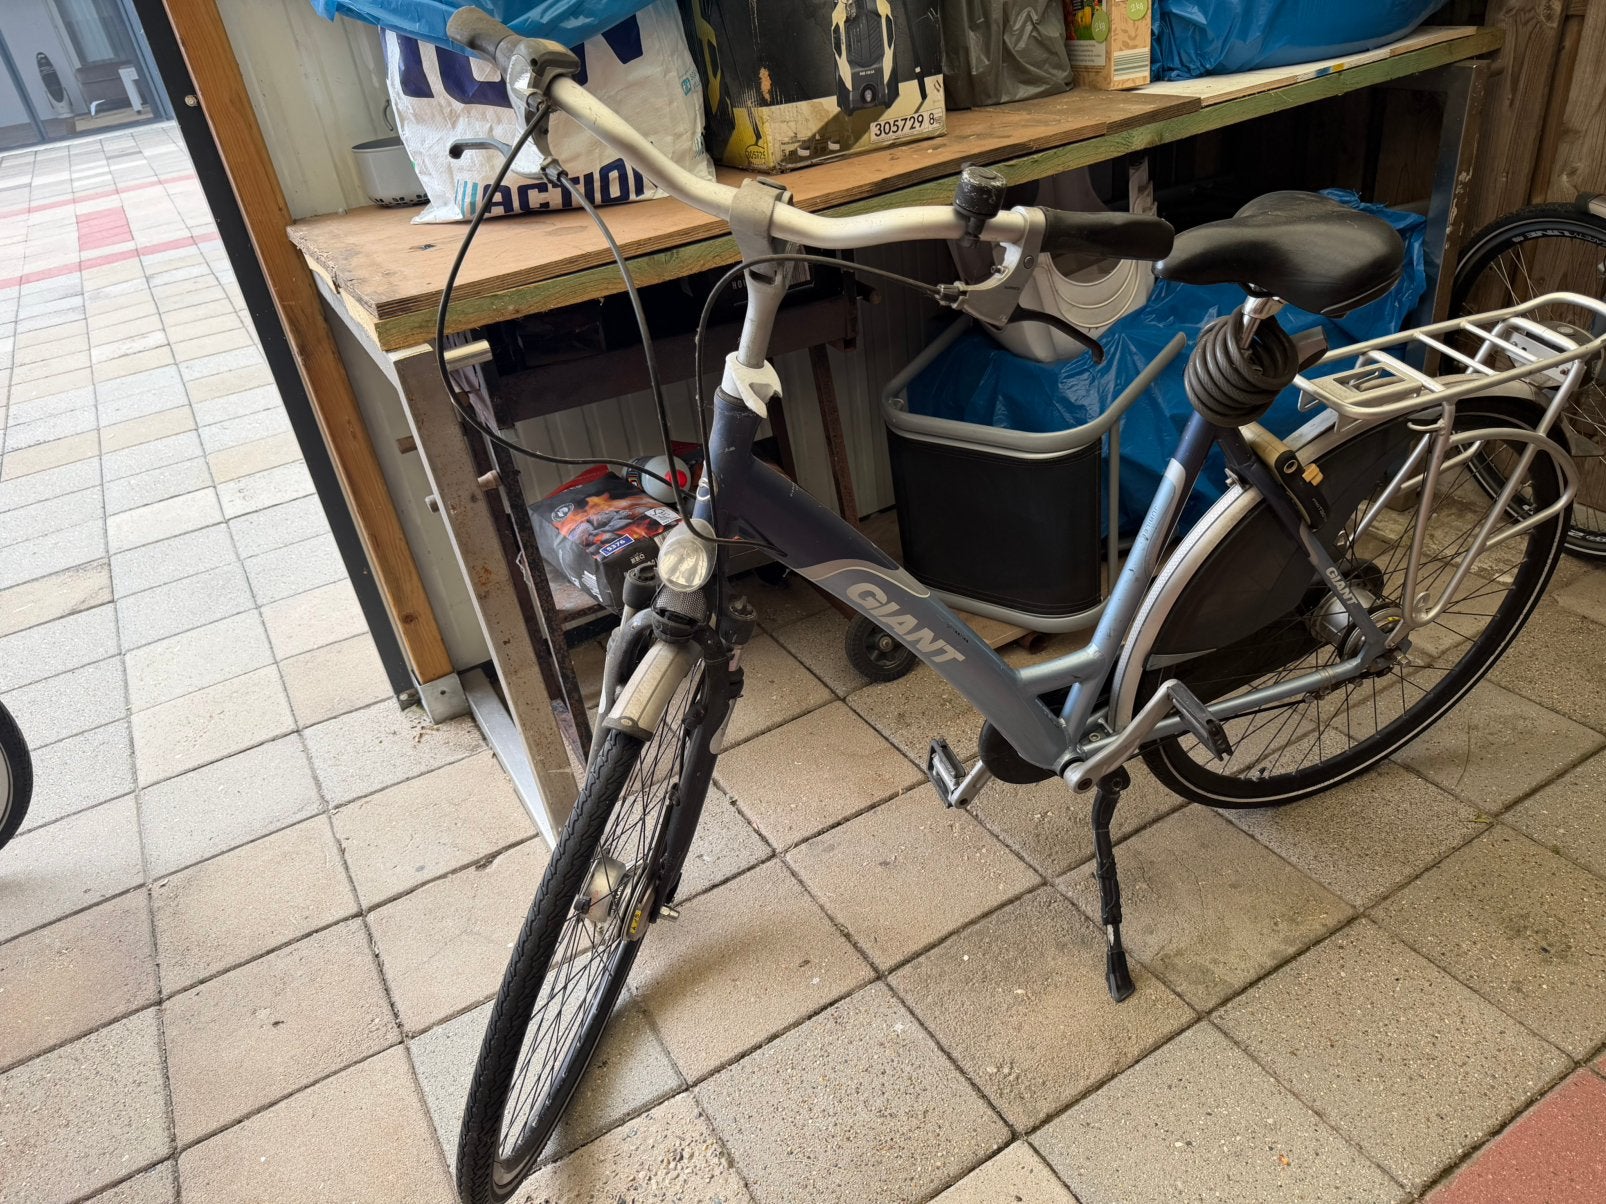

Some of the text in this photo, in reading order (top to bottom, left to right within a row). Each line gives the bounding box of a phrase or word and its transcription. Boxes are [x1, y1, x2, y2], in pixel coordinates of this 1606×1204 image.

[874, 113, 924, 138] 305729
[928, 112, 935, 126] 8
[1325, 566, 1358, 605] GIANT
[846, 582, 966, 663] GIANT
